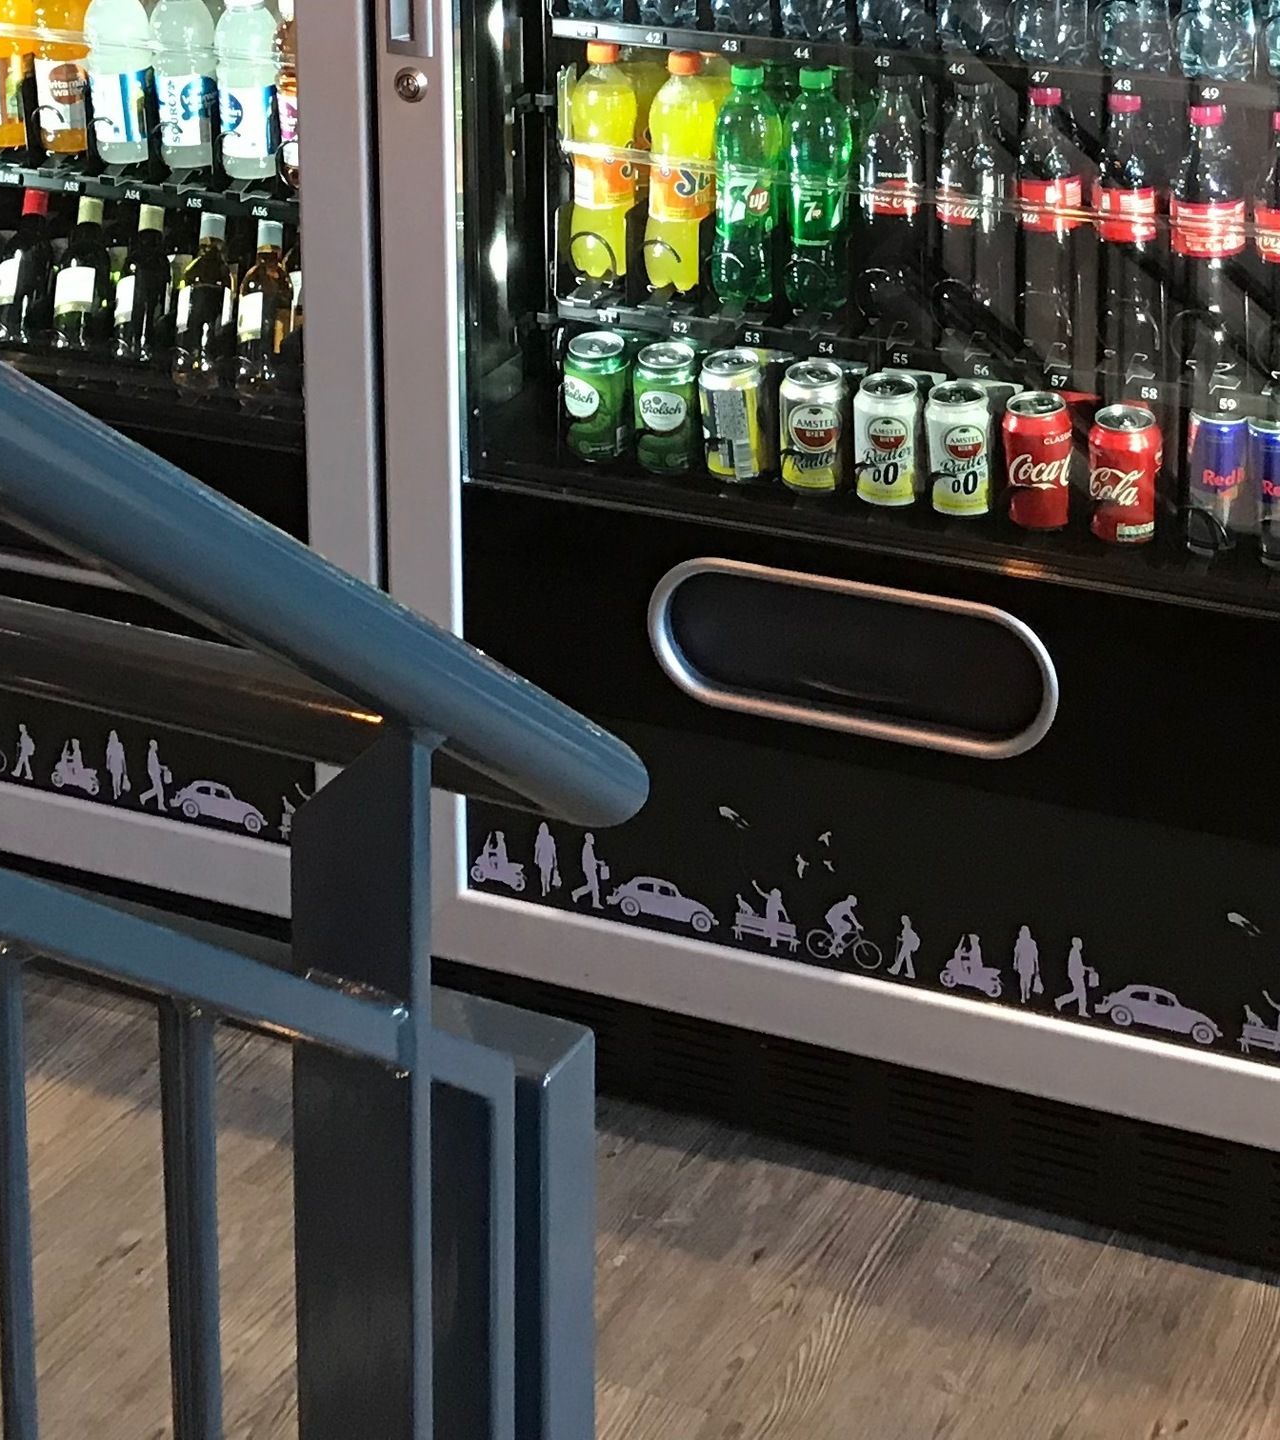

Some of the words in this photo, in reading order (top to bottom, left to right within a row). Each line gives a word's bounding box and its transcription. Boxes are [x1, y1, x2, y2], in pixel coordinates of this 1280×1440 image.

[645, 31, 661, 44] 42
[722, 39, 738, 52] 43
[793, 47, 810, 60] 44
[873, 55, 890, 69] 45
[948, 63, 966, 76] 46
[1031, 70, 1050, 84] 47
[1114, 78, 1132, 92] 48
[1201, 86, 1220, 100] 49
[64, 180, 79, 193] A53
[125, 188, 141, 201] A54
[186, 196, 202, 209] A55
[252, 204, 268, 217] A56
[672, 321, 689, 334] 52
[744, 330, 761, 344] 53
[818, 342, 834, 355] 54
[892, 352, 909, 365] 55
[973, 364, 990, 377] 56
[1051, 374, 1068, 388] 57
[1141, 386, 1158, 400] 58
[641, 398, 682, 416] Grolsch
[1219, 397, 1238, 411] 59
[796, 418, 834, 428] AMSTEL
[873, 427, 903, 436] AMSTEL
[949, 435, 979, 444] AMSTEL
